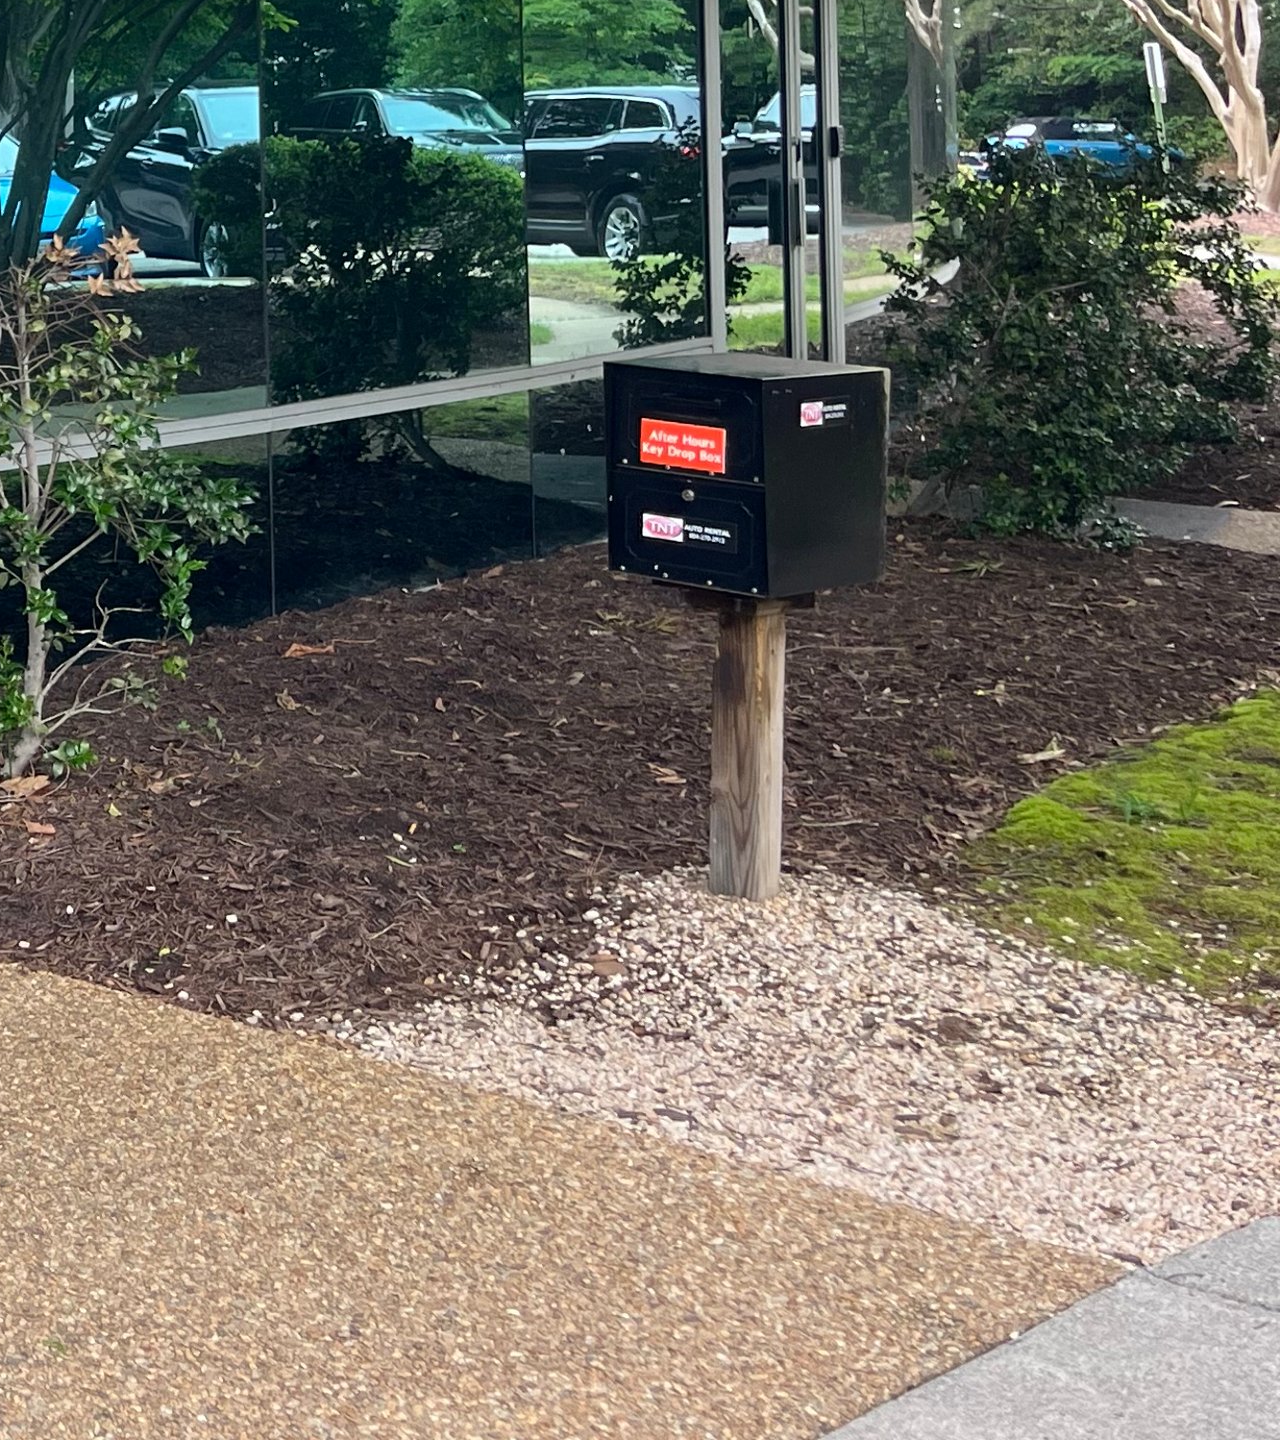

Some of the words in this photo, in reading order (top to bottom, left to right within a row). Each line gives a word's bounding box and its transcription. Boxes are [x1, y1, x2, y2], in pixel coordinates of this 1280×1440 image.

[649, 430, 679, 444] After
[682, 433, 715, 449] Hours
[642, 441, 664, 458] Key
[667, 445, 696, 462] Drop
[698, 449, 721, 464] Box
[648, 520, 676, 535] TNT
[684, 524, 704, 533] AUTO
[704, 526, 732, 538] RENTAL
